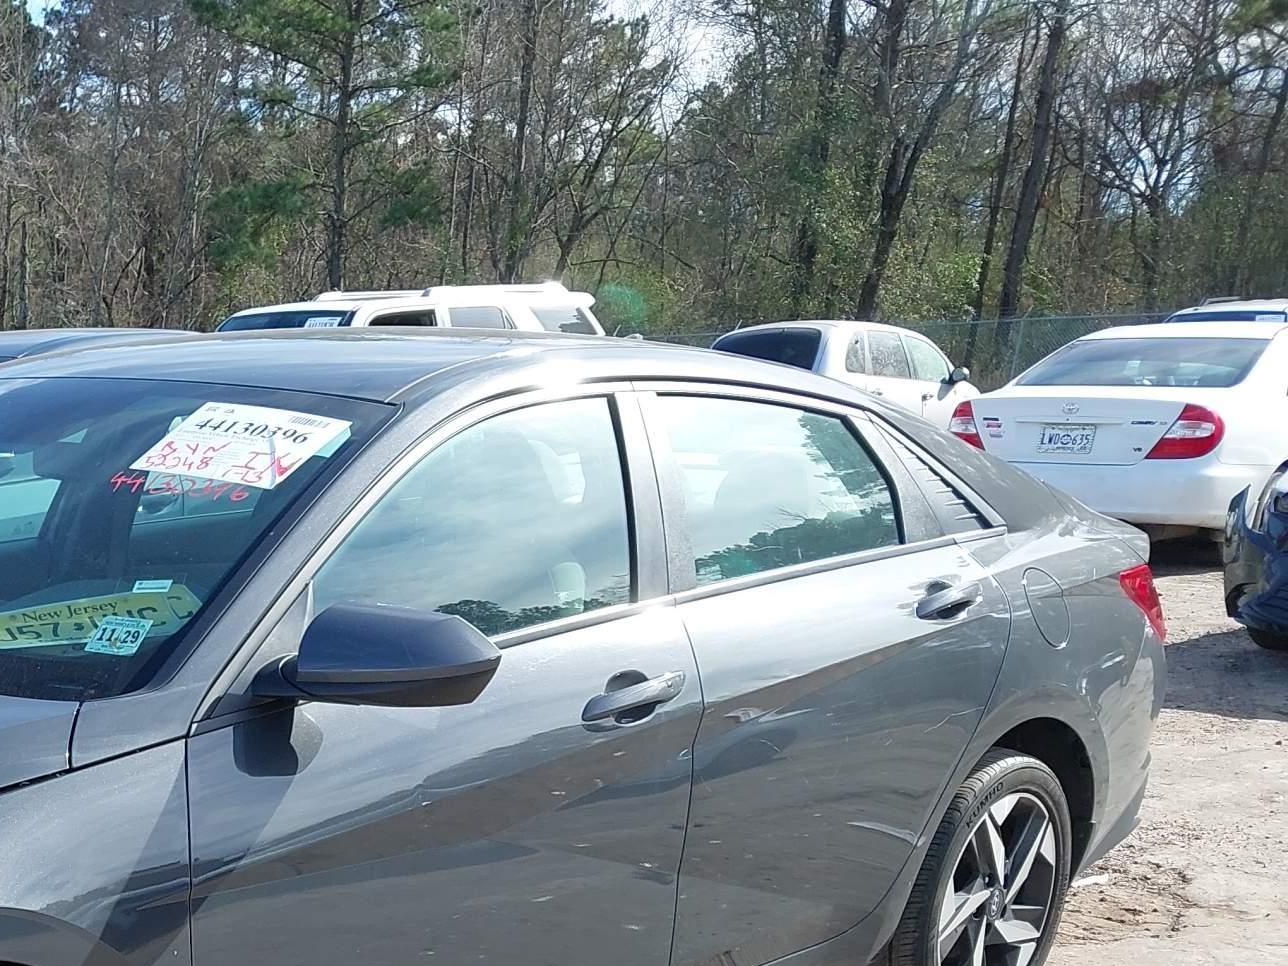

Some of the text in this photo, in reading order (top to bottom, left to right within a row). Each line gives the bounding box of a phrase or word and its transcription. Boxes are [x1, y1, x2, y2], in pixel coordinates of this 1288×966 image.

[195, 418, 313, 444] 44130396
[1072, 433, 1091, 445] 635
[22, 610, 62, 624] New
[66, 601, 117, 619] Jersey
[0, 621, 61, 642] J57
[96, 626, 141, 644] 11 29
[966, 781, 1004, 829] KUMHO
